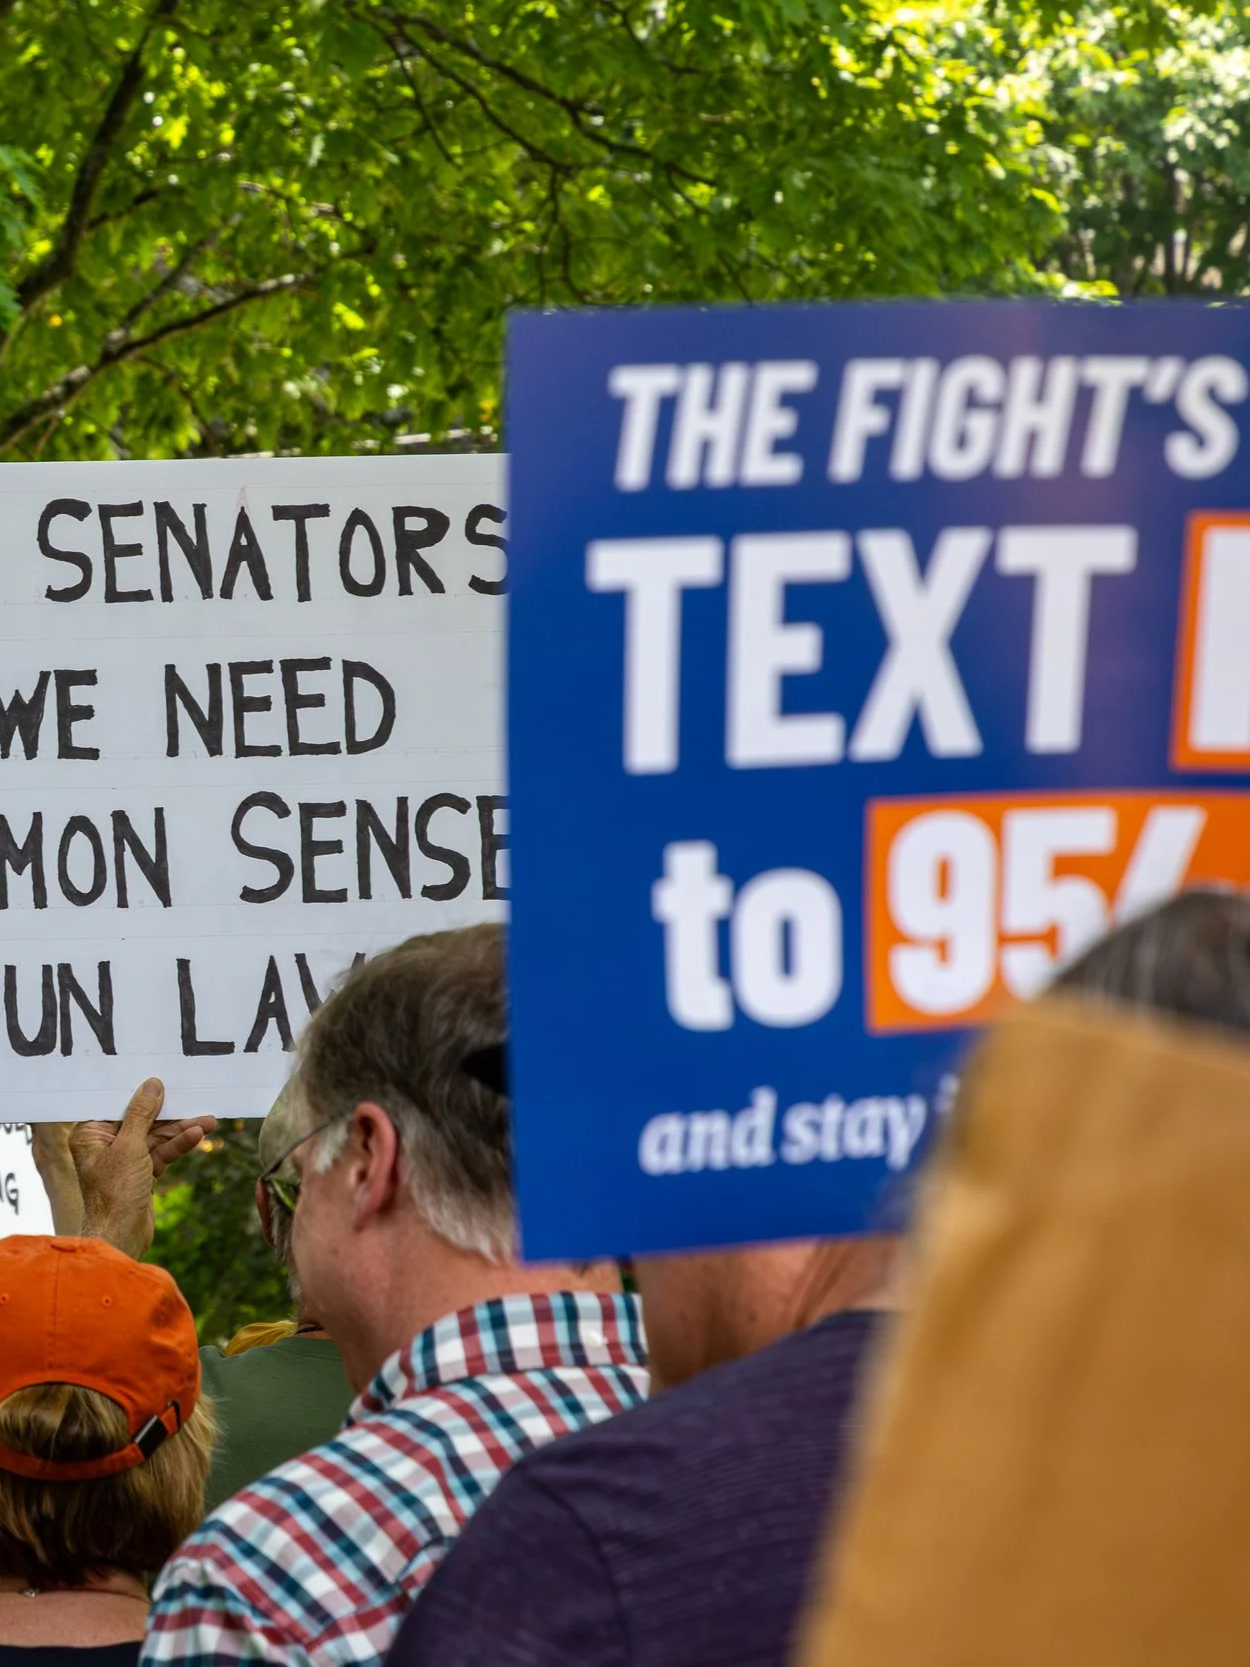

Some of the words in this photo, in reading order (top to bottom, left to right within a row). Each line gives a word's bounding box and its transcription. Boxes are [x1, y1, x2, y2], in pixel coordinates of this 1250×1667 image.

[608, 360, 819, 492] THE
[828, 355, 1248, 482] FIGHT'S
[37, 499, 507, 603] SENATORS
[164, 656, 396, 758] NEED
[585, 526, 1138, 775] TEXT
[229, 790, 507, 904] SENSE
[651, 839, 844, 1033] to
[638, 1084, 777, 1176] and
[781, 1092, 927, 1171] stay
